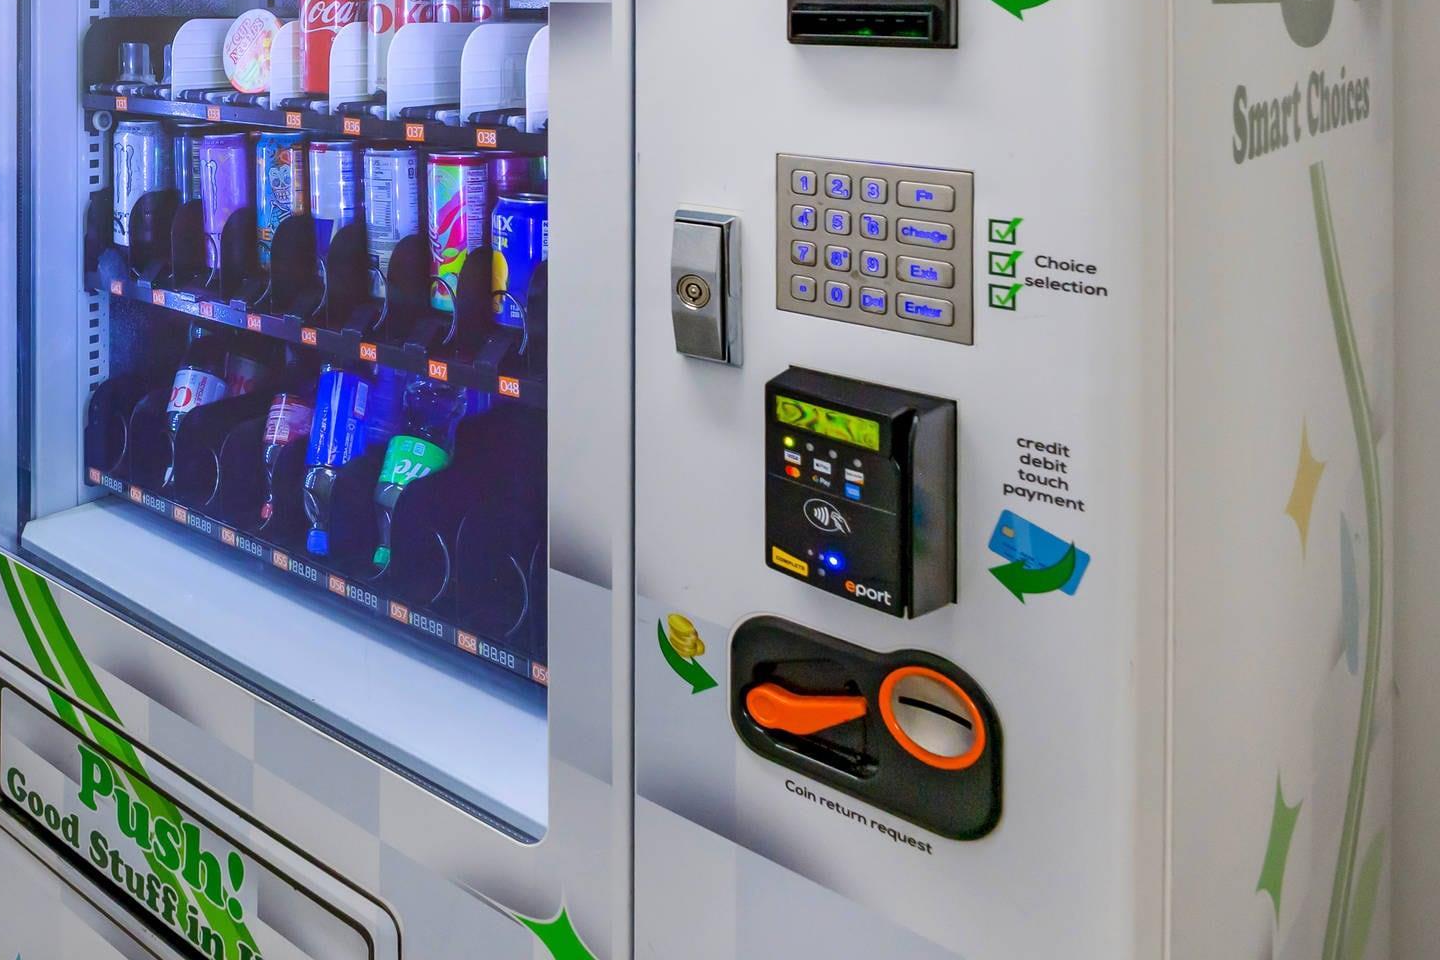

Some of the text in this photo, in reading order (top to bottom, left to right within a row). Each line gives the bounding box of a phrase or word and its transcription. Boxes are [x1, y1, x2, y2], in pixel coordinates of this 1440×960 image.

[287, 114, 301, 127] 035
[1233, 65, 1370, 165] Smart Choices
[344, 120, 360, 133] 036
[406, 126, 424, 139] 037
[477, 132, 497, 145] 038
[800, 175, 808, 191] 1
[831, 179, 843, 195] 2
[867, 183, 880, 199] 3
[832, 214, 843, 231] 5
[867, 220, 879, 236] 6
[798, 246, 809, 261] 7
[830, 251, 843, 267] 8
[867, 256, 879, 272] 9
[1034, 255, 1097, 274] Choice
[830, 287, 843, 302] 0
[1025, 276, 1108, 297] selection
[904, 300, 942, 318] Enter
[301, 329, 317, 343] 045
[360, 345, 377, 358] 046
[429, 364, 447, 378] 047
[499, 379, 520, 395] 048
[1016, 436, 1071, 458] credit
[1019, 453, 1068, 474] debit
[1017, 468, 1069, 491] touch
[1003, 483, 1086, 512] payment
[329, 576, 345, 593] 056
[845, 580, 892, 606] eport
[391, 603, 407, 619] 057
[458, 634, 477, 651] 058
[785, 779, 933, 855] Coin return request
[77, 744, 245, 922] Push!
[7, 766, 224, 960] Good Stuff in
